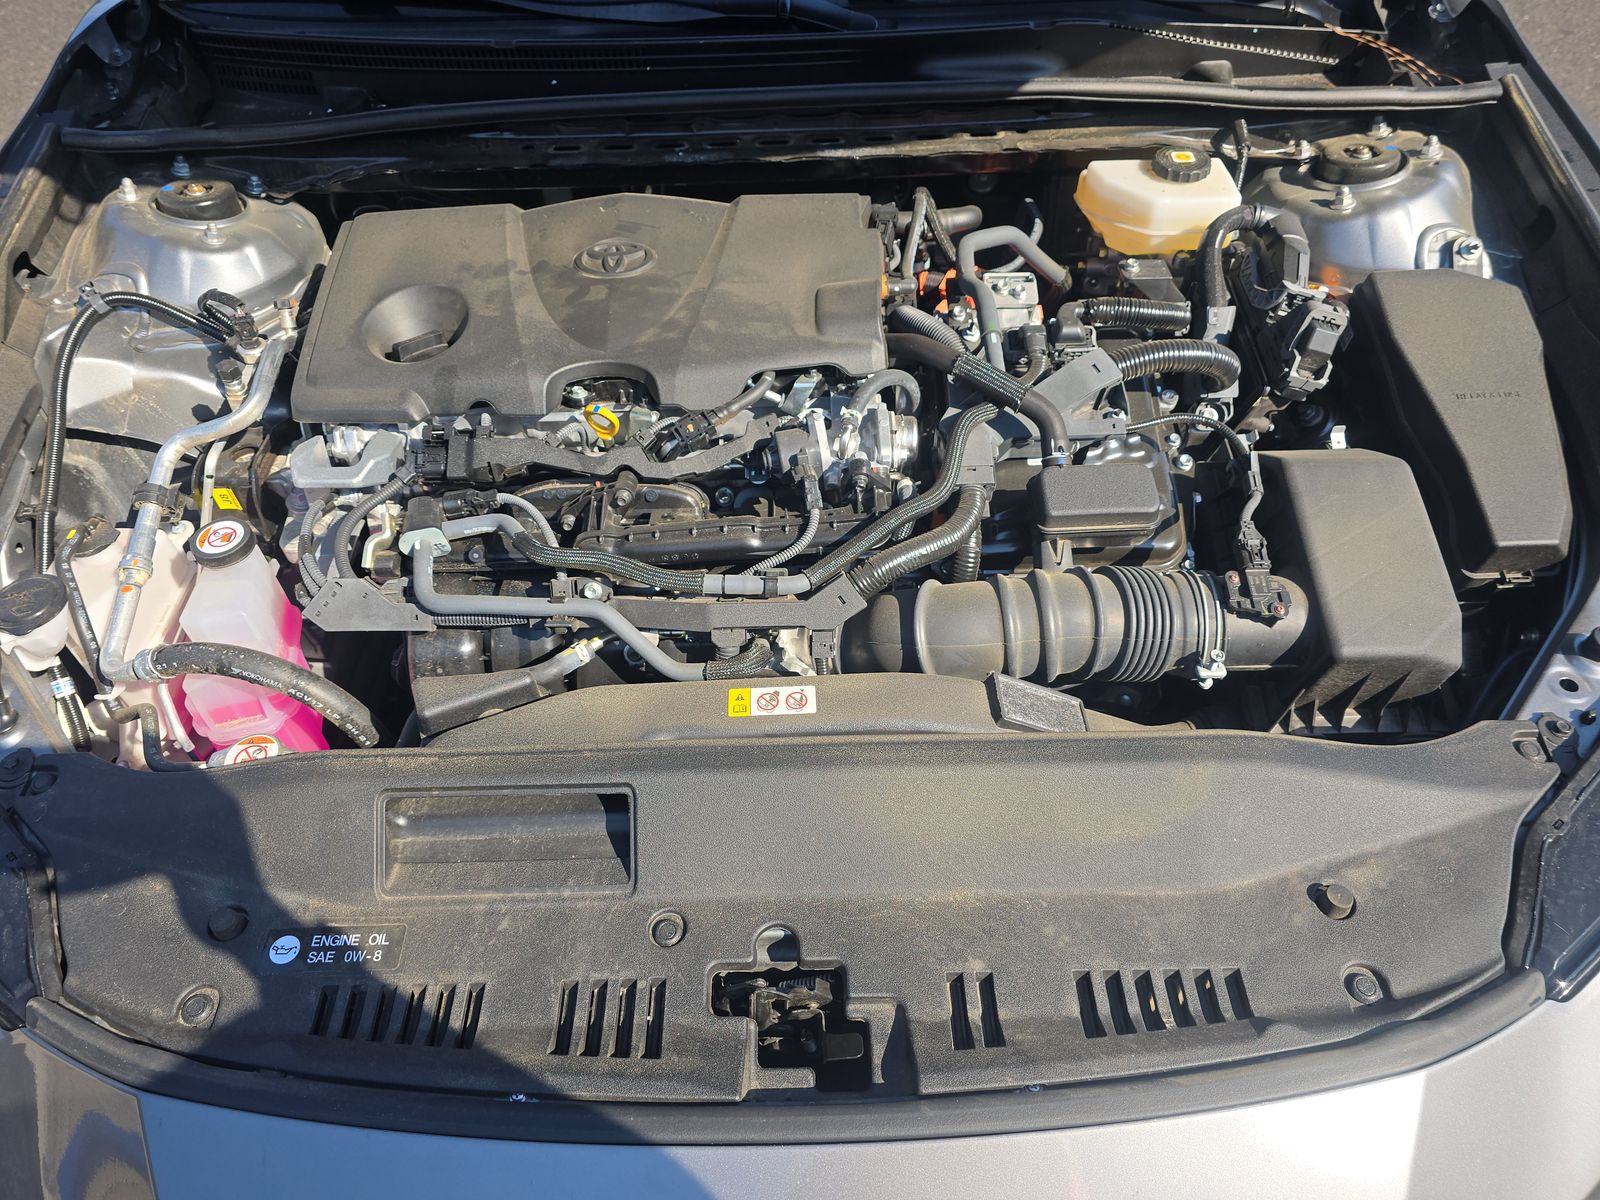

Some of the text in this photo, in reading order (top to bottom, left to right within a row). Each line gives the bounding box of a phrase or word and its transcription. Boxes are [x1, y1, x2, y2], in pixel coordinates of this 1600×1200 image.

[241, 670, 282, 688] YOKOHAMA
[287, 688, 324, 708] ACV17
[311, 933, 389, 946] ENGINE OIL
[307, 950, 382, 963] SAE 0W-8
